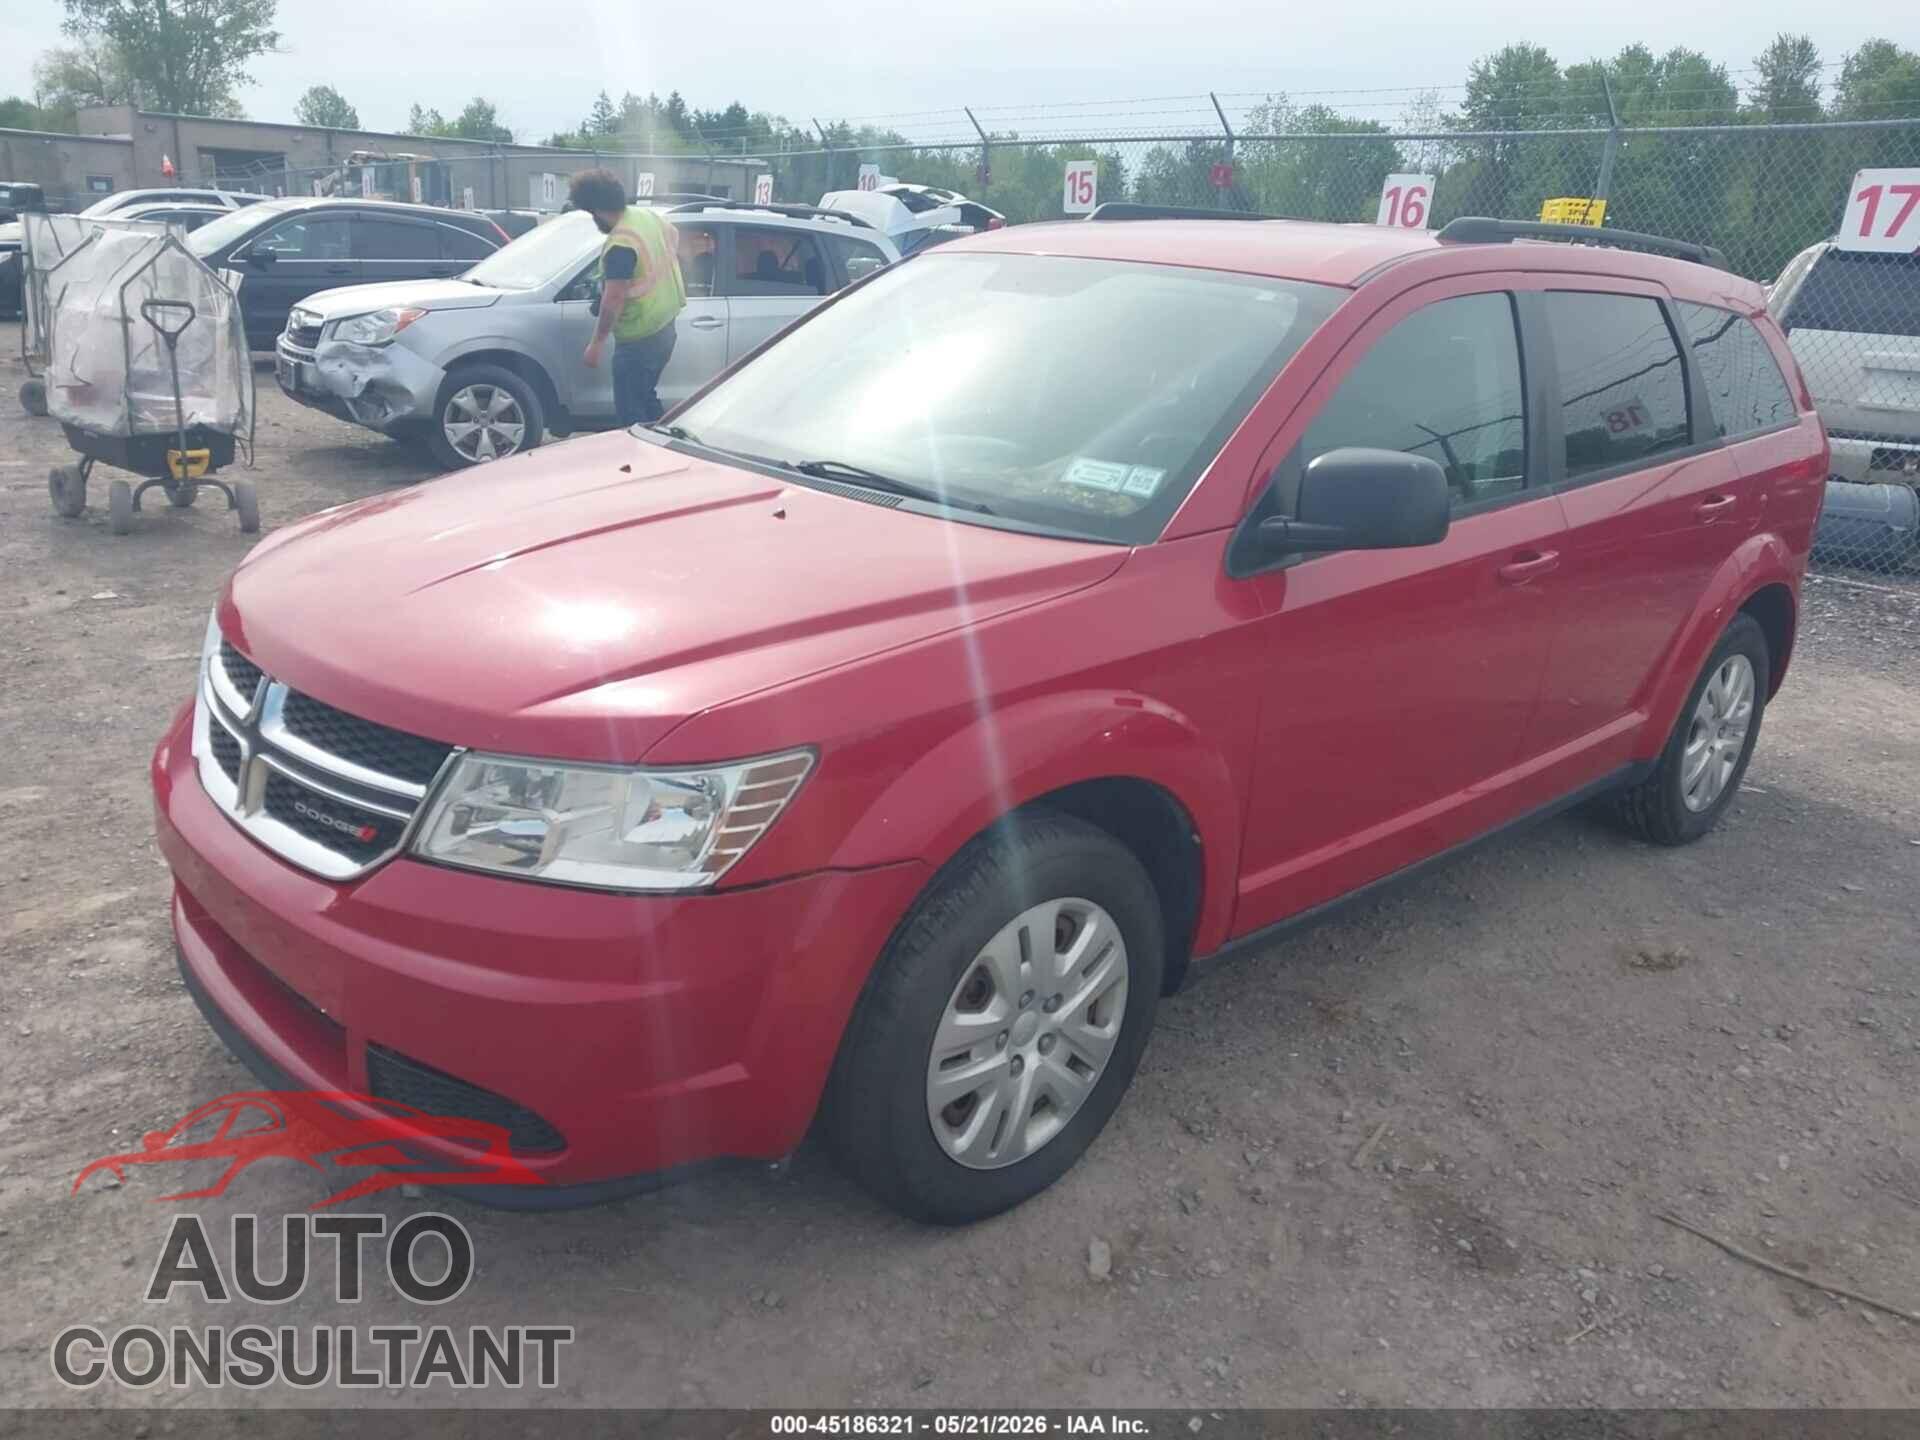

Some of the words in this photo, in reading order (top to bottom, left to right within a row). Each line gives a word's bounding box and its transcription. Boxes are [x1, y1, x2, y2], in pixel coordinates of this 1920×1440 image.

[640, 179, 652, 197] 12
[757, 183, 769, 205] 13
[1067, 170, 1093, 204] 15
[1385, 186, 1427, 228] 16
[1856, 184, 1920, 237] 17
[294, 801, 361, 837] DODGE
